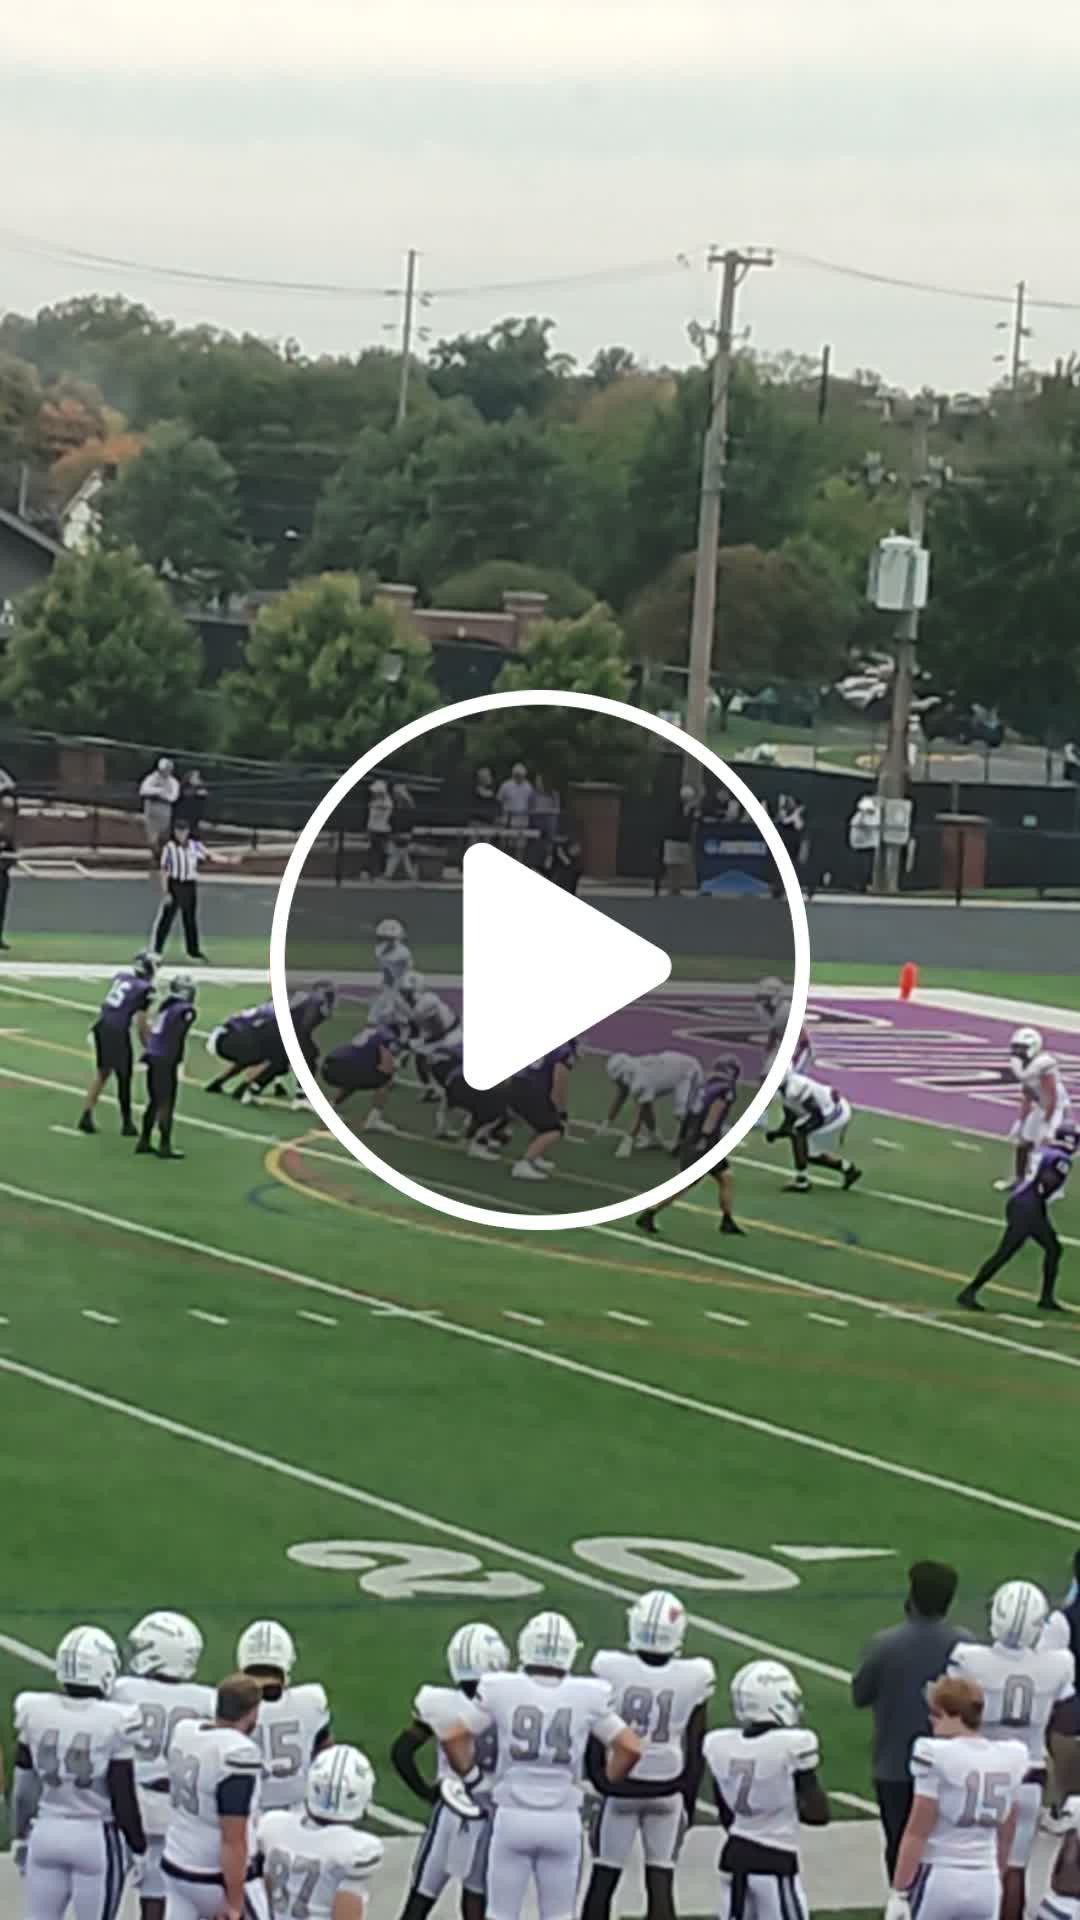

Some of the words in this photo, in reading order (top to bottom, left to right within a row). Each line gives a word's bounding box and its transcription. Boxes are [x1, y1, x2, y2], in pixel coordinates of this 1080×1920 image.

[286, 1536, 801, 1598] 20
[623, 1686, 674, 1743] 81
[1004, 1674, 1034, 1727] 0
[37, 1729, 94, 1789] 44
[509, 1705, 572, 1764] 94
[729, 1759, 756, 1816] 7
[956, 1770, 1012, 1828] 15
[267, 1848, 321, 1919] 87
